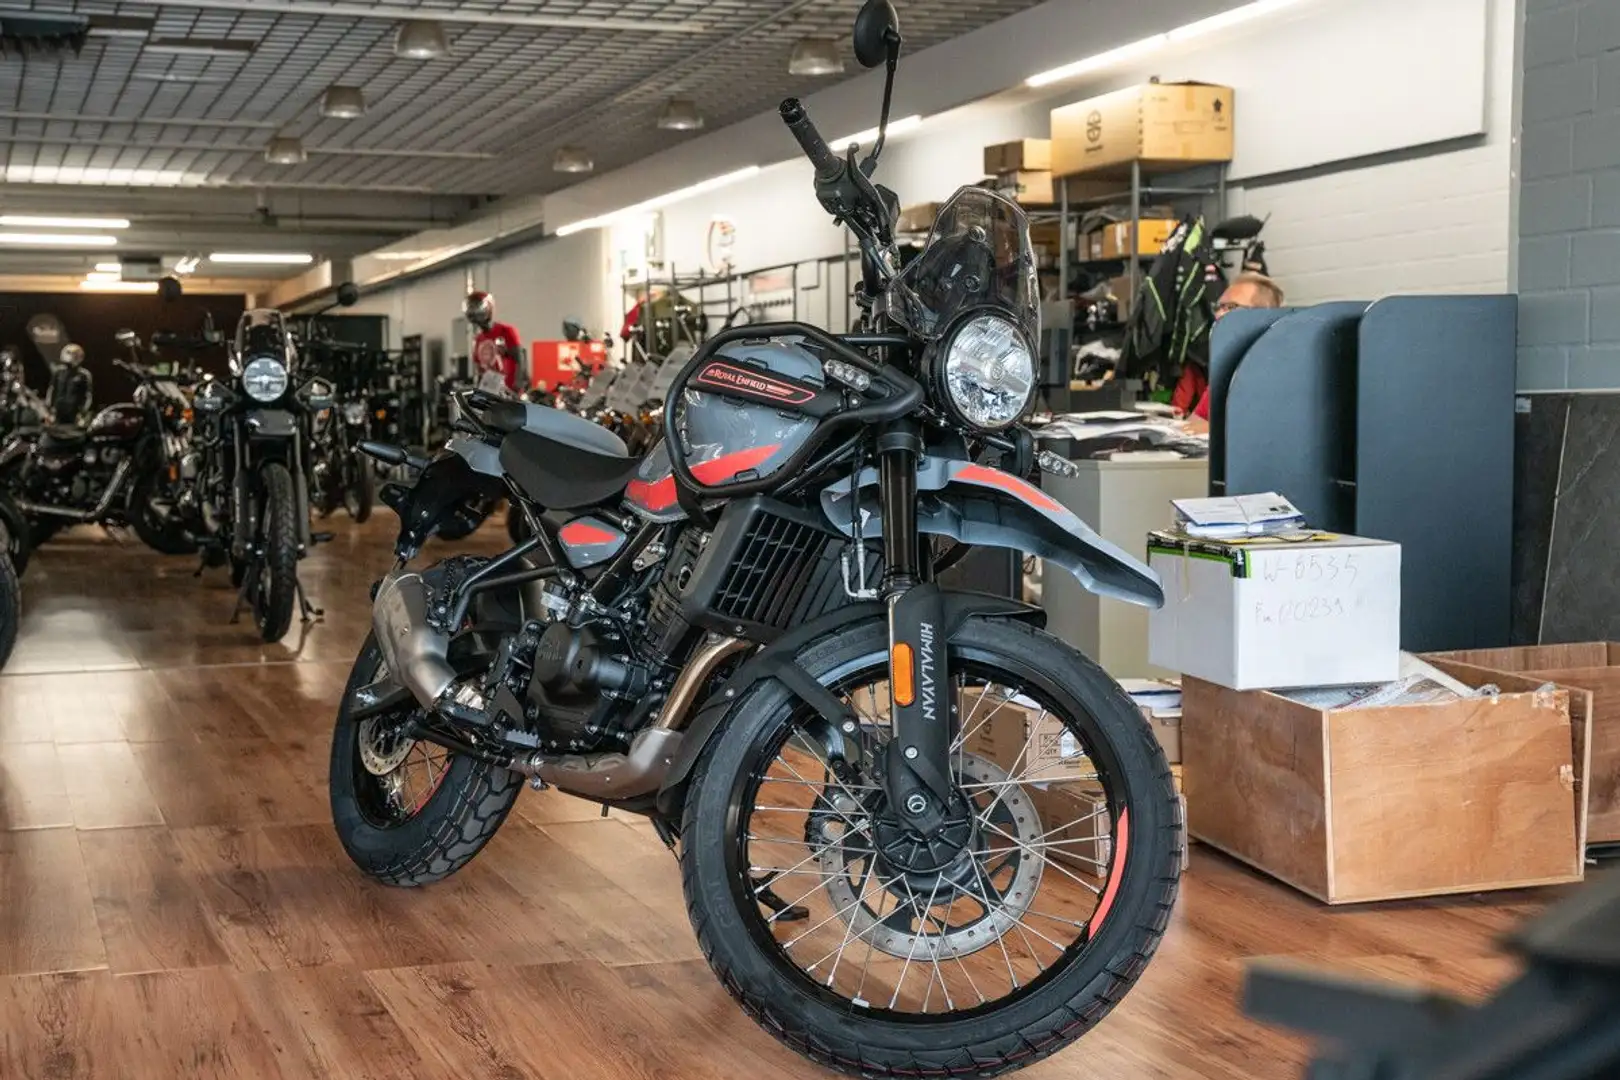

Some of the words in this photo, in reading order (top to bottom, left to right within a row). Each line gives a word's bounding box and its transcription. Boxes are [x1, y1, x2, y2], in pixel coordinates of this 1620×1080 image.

[713, 368, 735, 382] ROYAL
[736, 374, 767, 390] ENFIELD
[920, 622, 936, 720] HIMALAYAN
